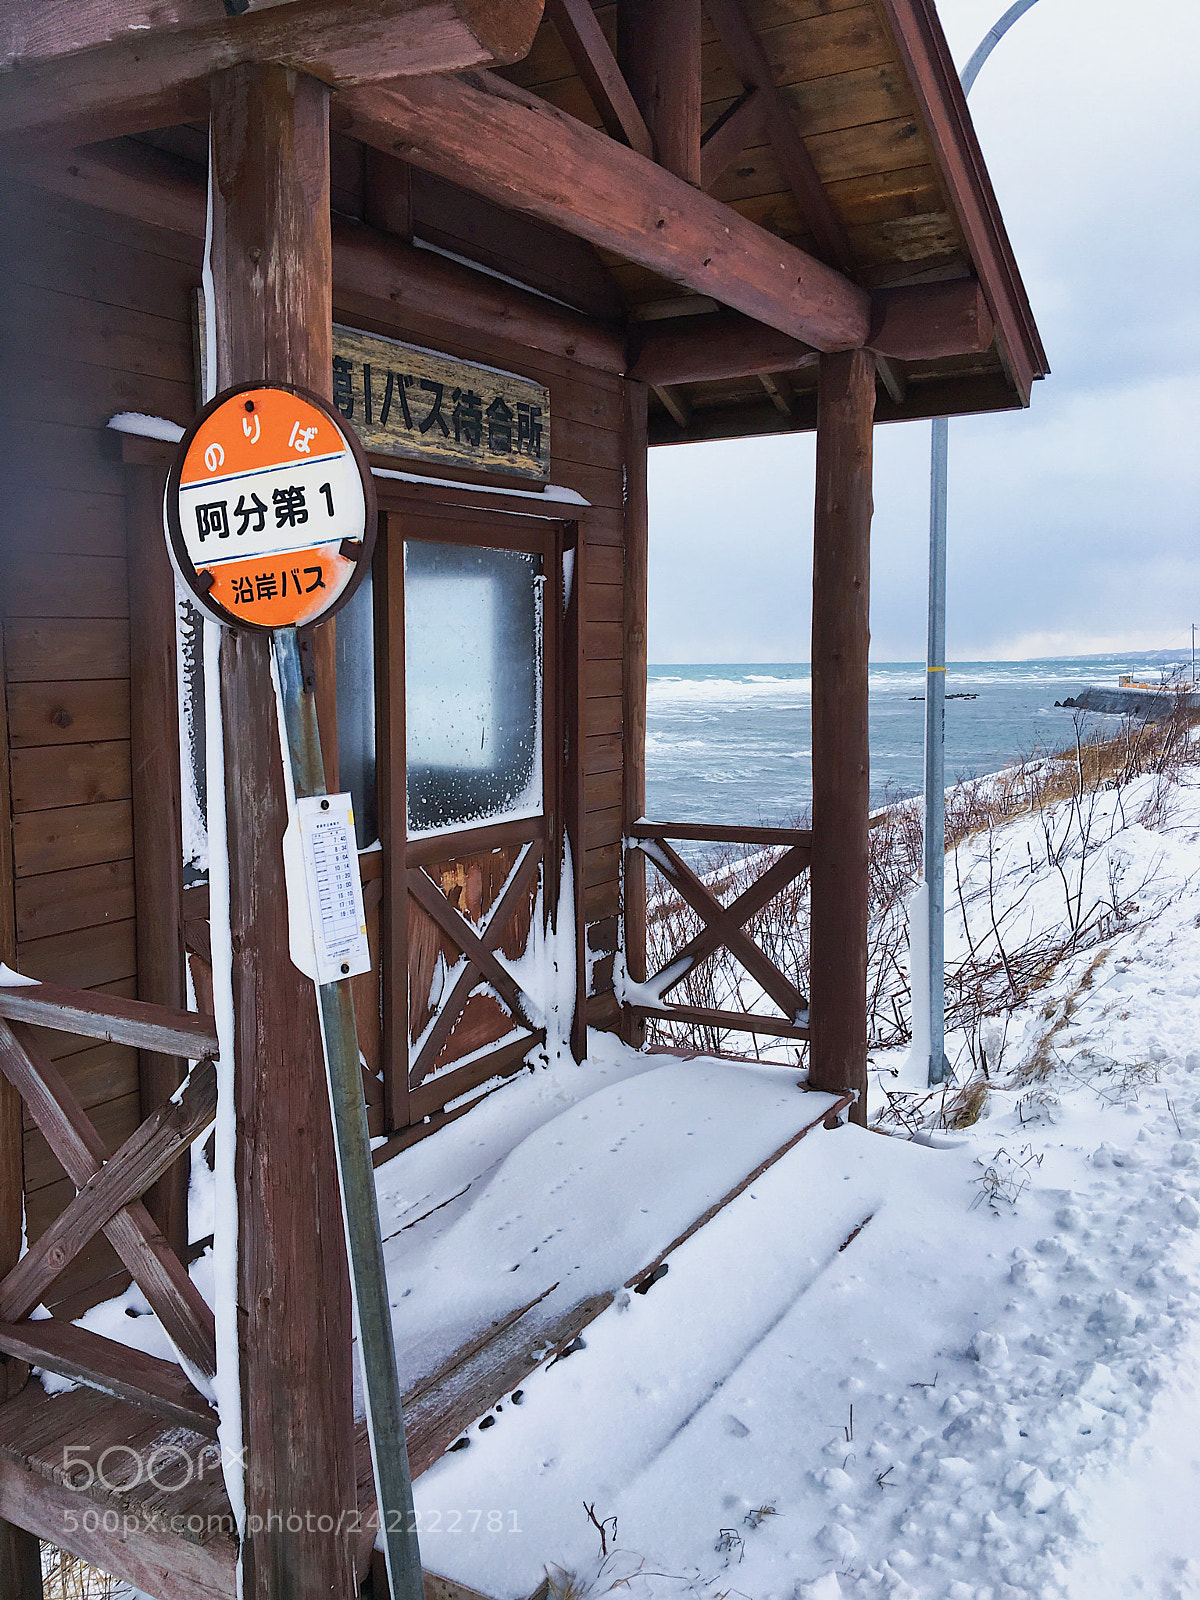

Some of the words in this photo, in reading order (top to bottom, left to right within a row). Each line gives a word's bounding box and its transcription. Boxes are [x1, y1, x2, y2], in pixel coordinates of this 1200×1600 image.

[204, 414, 318, 472] のりば
[195, 482, 336, 543] 阿分第1
[230, 565, 327, 605] 沿岸バス
